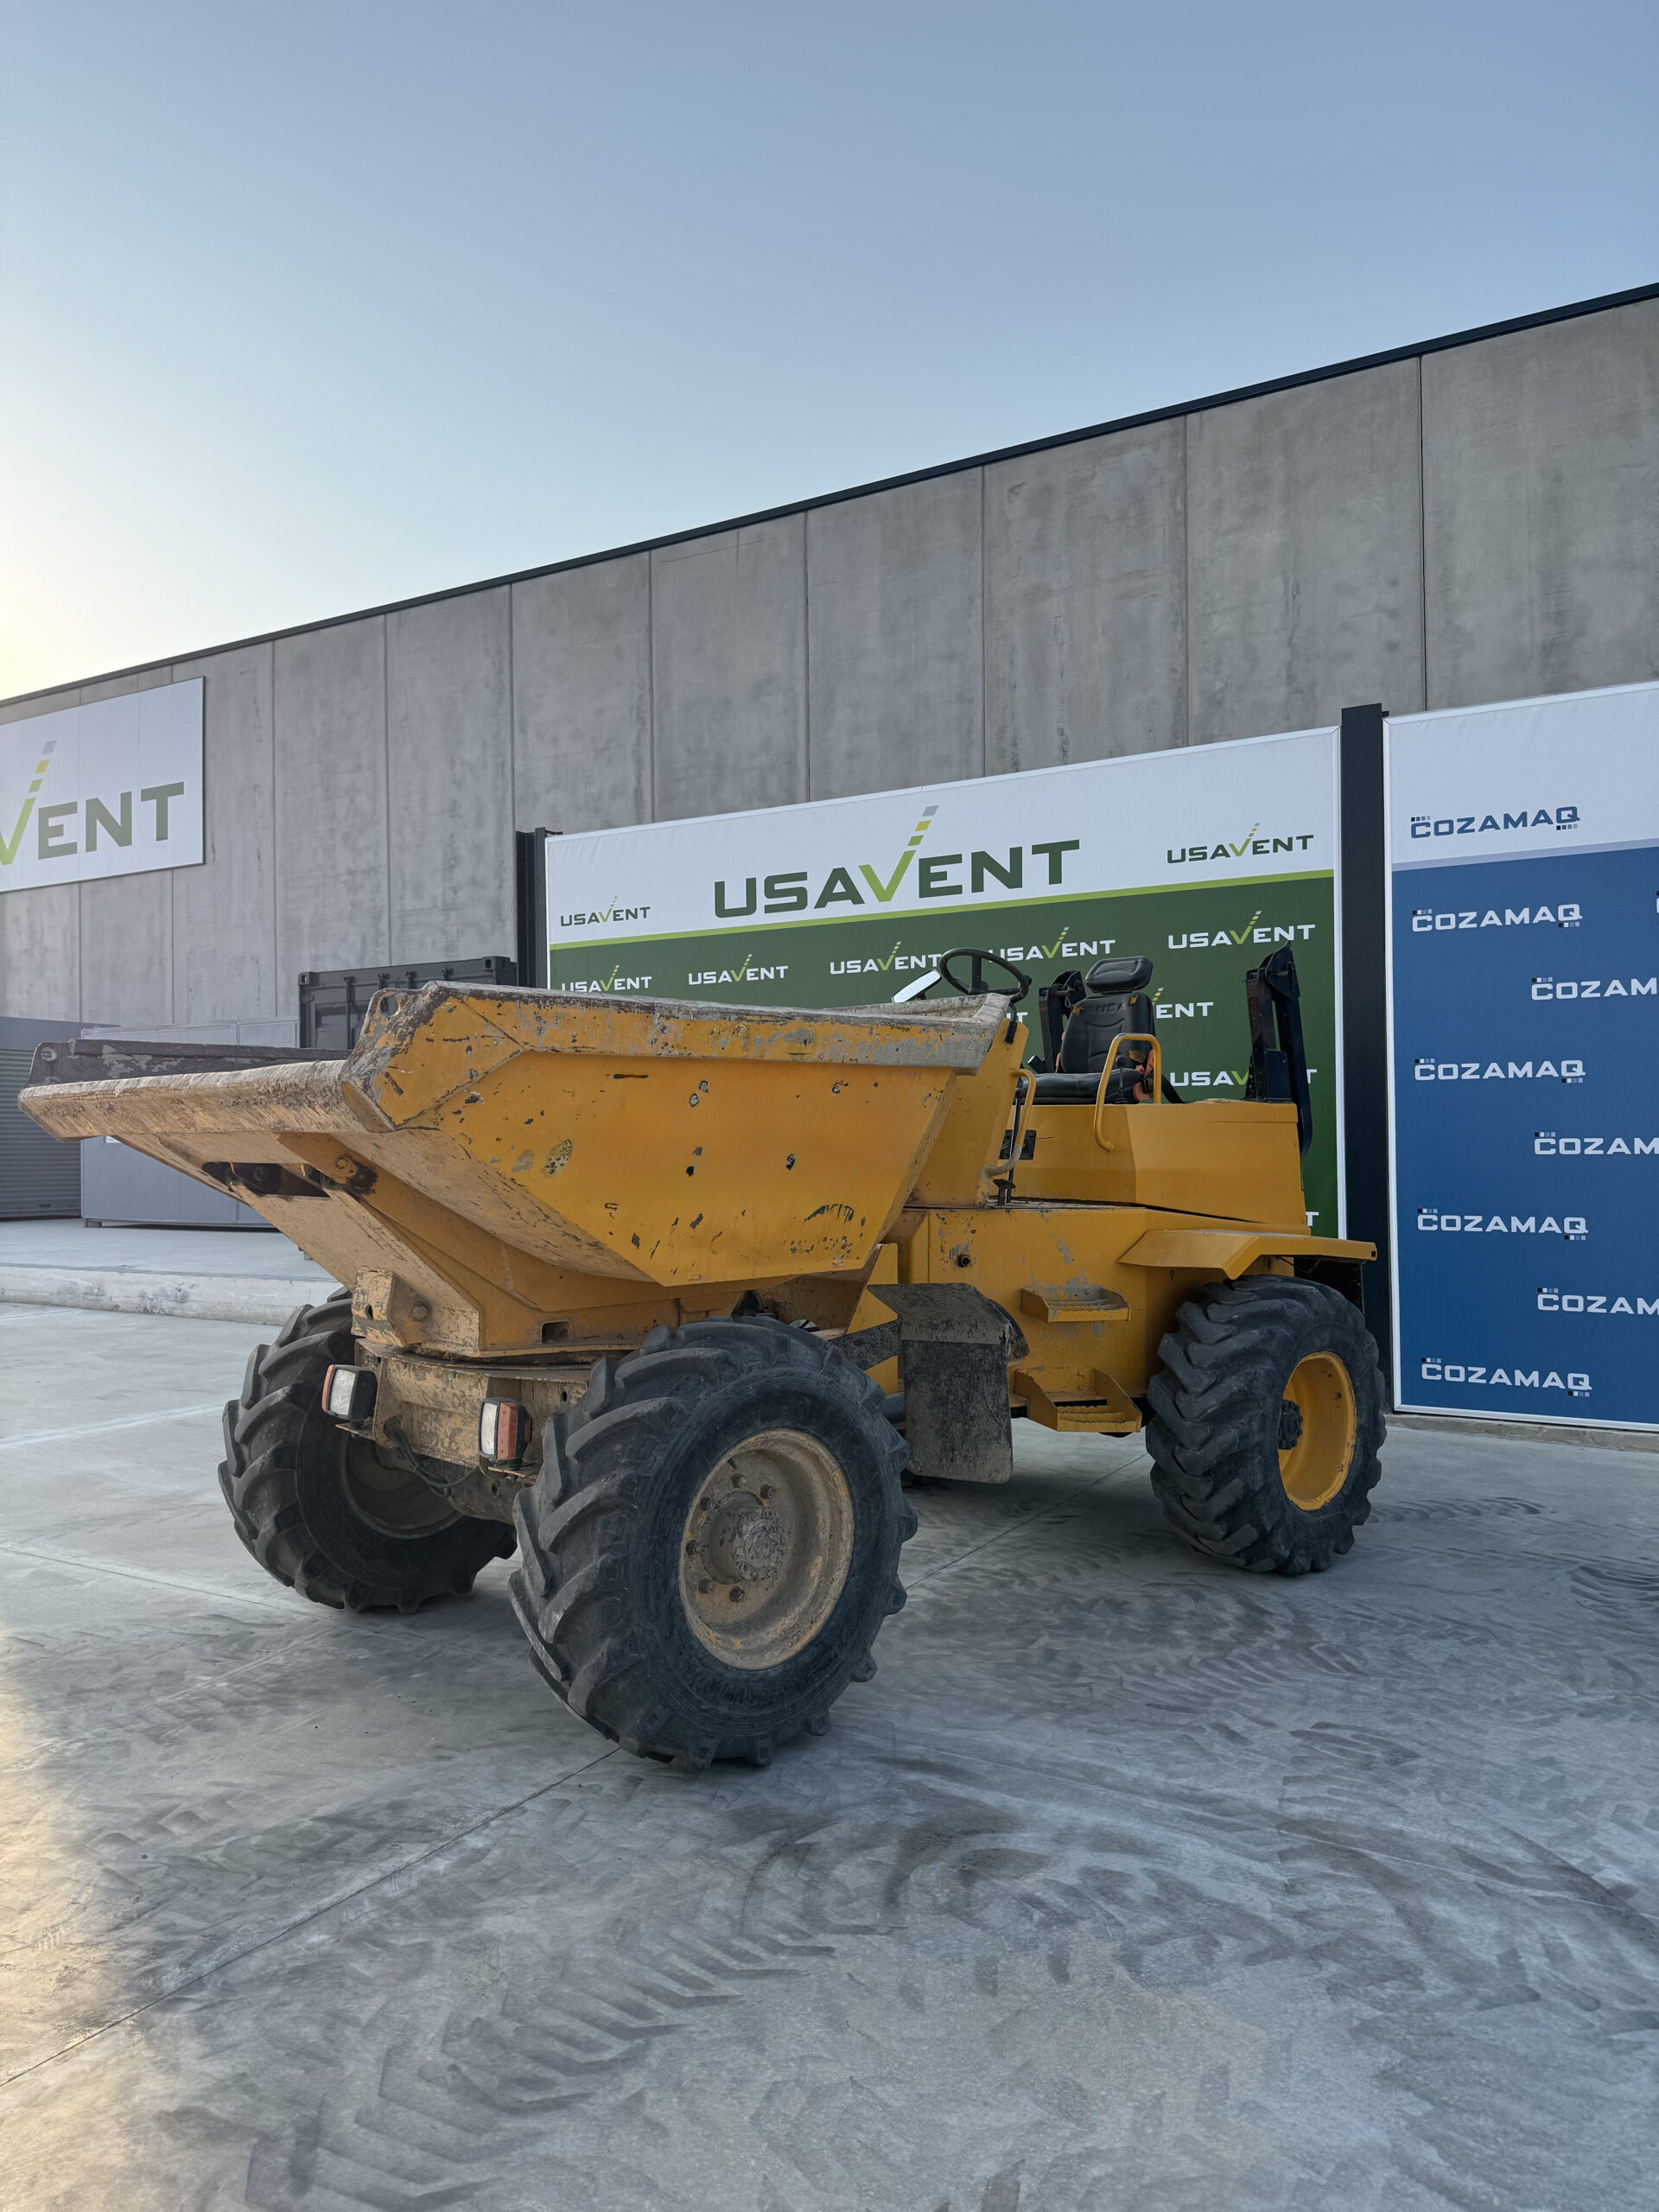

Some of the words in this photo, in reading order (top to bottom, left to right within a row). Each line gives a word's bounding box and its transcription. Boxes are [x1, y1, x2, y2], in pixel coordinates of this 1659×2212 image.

[1411, 806, 1580, 838] COZAMAQ
[1167, 835, 1313, 863] USAVENT
[715, 840, 1080, 918] USAVENT
[561, 906, 650, 926] USAVENT
[1412, 904, 1582, 932] COZAMAQ
[1168, 925, 1315, 949] USAVENT
[689, 966, 788, 985] USAVENT
[830, 954, 941, 975] USAVENT
[562, 976, 652, 992] USAVENT
[1531, 977, 1657, 1000] COZAM
[1414, 1060, 1586, 1081] COZAMAQ
[1418, 1215, 1588, 1234] COZAMAQ
[1421, 1363, 1592, 1390] COZAMAQ
